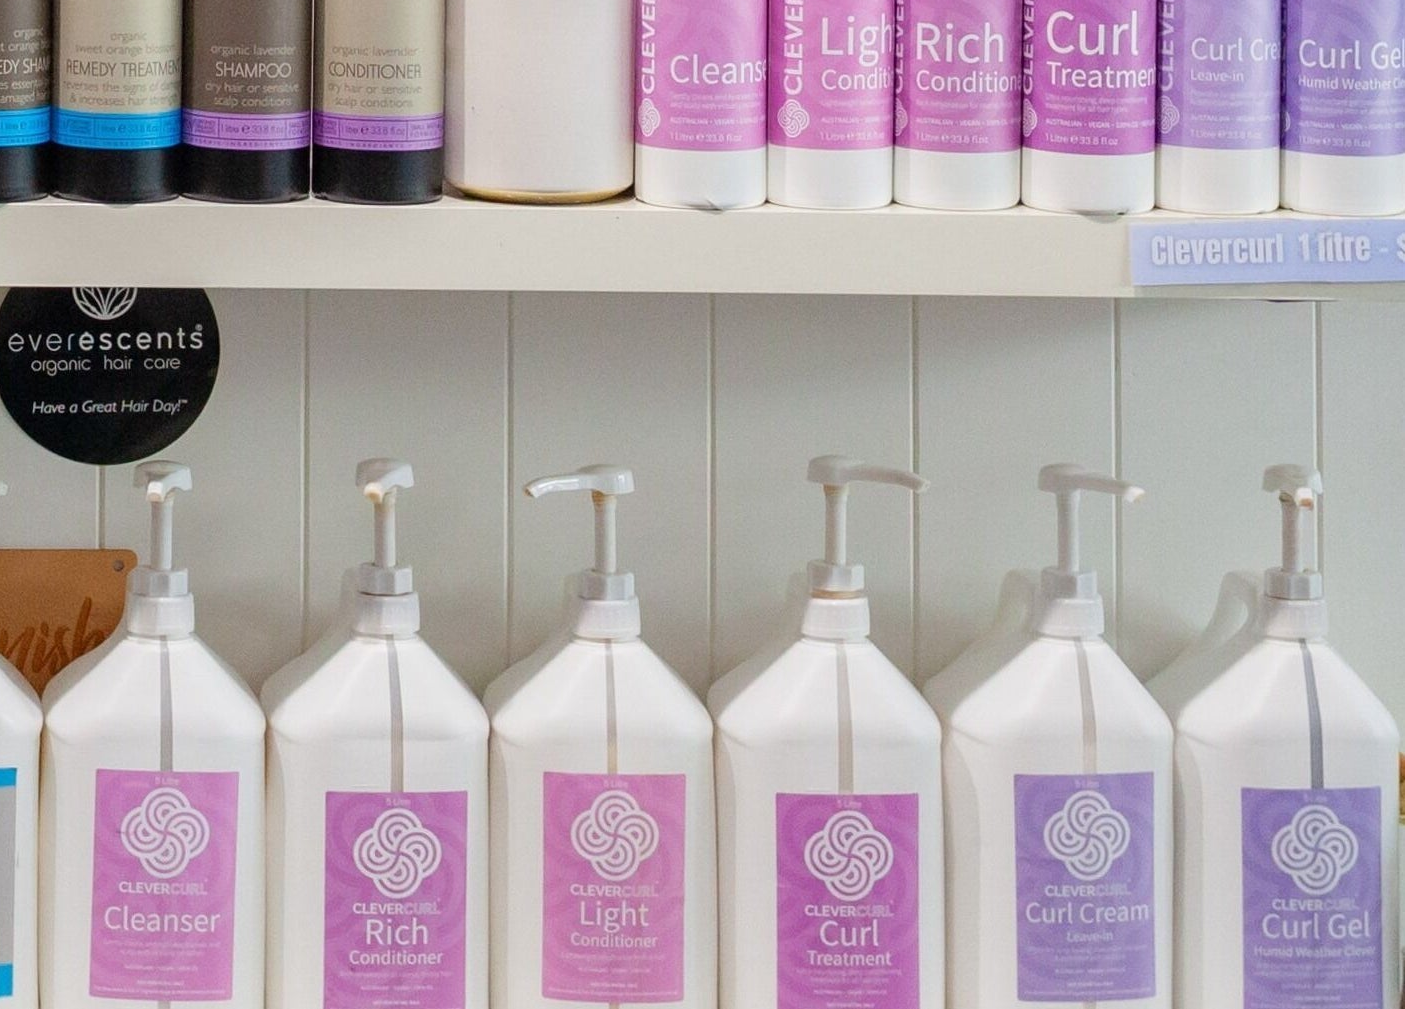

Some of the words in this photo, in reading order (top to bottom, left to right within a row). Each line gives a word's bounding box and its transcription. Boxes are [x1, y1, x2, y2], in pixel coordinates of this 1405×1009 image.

[915, 22, 1004, 64] Rich
[1045, 9, 1139, 57] Curl
[1190, 37, 1243, 62] Curl
[1248, 38, 1281, 63] Cre
[1298, 39, 1361, 70] Curl
[1370, 41, 1405, 70] Gel
[66, 58, 117, 78] REMEDY
[214, 60, 293, 79] SHAMPOO
[327, 60, 423, 80] CONDITIONER
[1190, 68, 1244, 83] Leave-in
[915, 72, 1019, 94] Condition
[1298, 75, 1339, 90] Humid
[1341, 76, 1392, 91] Weather
[1151, 234, 1284, 267] Clevercurl
[1298, 233, 1311, 262] 1
[1317, 231, 1372, 263] litre
[8, 326, 204, 353] everescents
[31, 355, 92, 377] organic
[103, 354, 134, 371] hair
[143, 357, 182, 371] care
[32, 400, 66, 415] Have
[69, 403, 79, 413] a
[81, 400, 118, 413] Great
[120, 399, 149, 413] Hair
[119, 880, 208, 897] CLEVERCURL
[569, 883, 659, 899] CLEVERCURL
[1044, 884, 1131, 899] CLEVERCURL
[352, 901, 442, 917] CLEVERCURL
[803, 903, 894, 919] CLEVERCURL
[1024, 902, 1073, 926] Curl
[1079, 902, 1150, 926] Cream
[1270, 898, 1360, 913] CLEVERCURL
[103, 906, 221, 934] Cleanser
[579, 900, 650, 933] Light
[365, 918, 429, 946] Rich
[818, 919, 880, 949] Curl
[1260, 913, 1320, 941] Curl
[1327, 913, 1371, 941] Gel
[569, 932, 659, 950] Conditioner
[1066, 930, 1115, 945] Leave-in
[348, 948, 443, 968] Conditioner
[806, 950, 892, 969] Treatment
[1252, 945, 1293, 959] Humid
[1294, 945, 1343, 959] Weather
